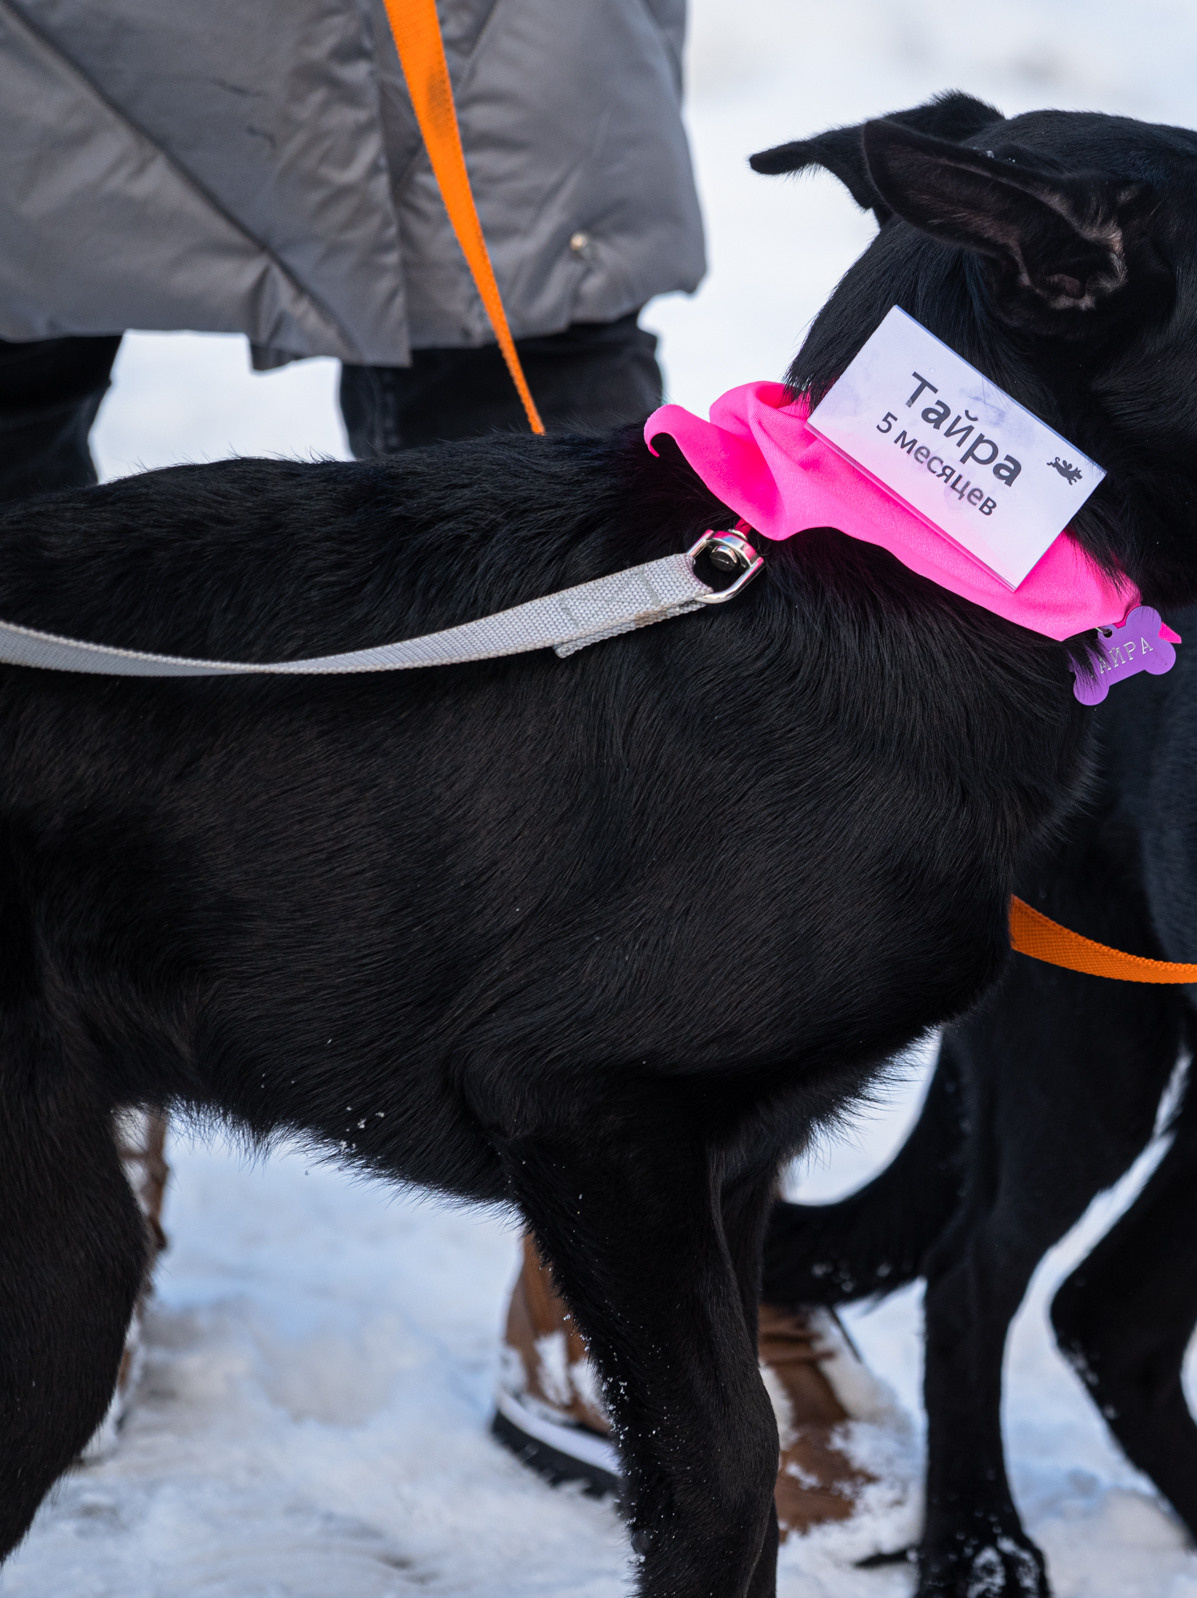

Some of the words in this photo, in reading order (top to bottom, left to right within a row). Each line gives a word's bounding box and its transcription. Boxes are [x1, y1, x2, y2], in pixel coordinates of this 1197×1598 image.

[876, 412, 898, 434] 5
[893, 429, 998, 517] месяцев
[904, 371, 1022, 487] Тайра
[1089, 636, 1153, 678] АЙРА
